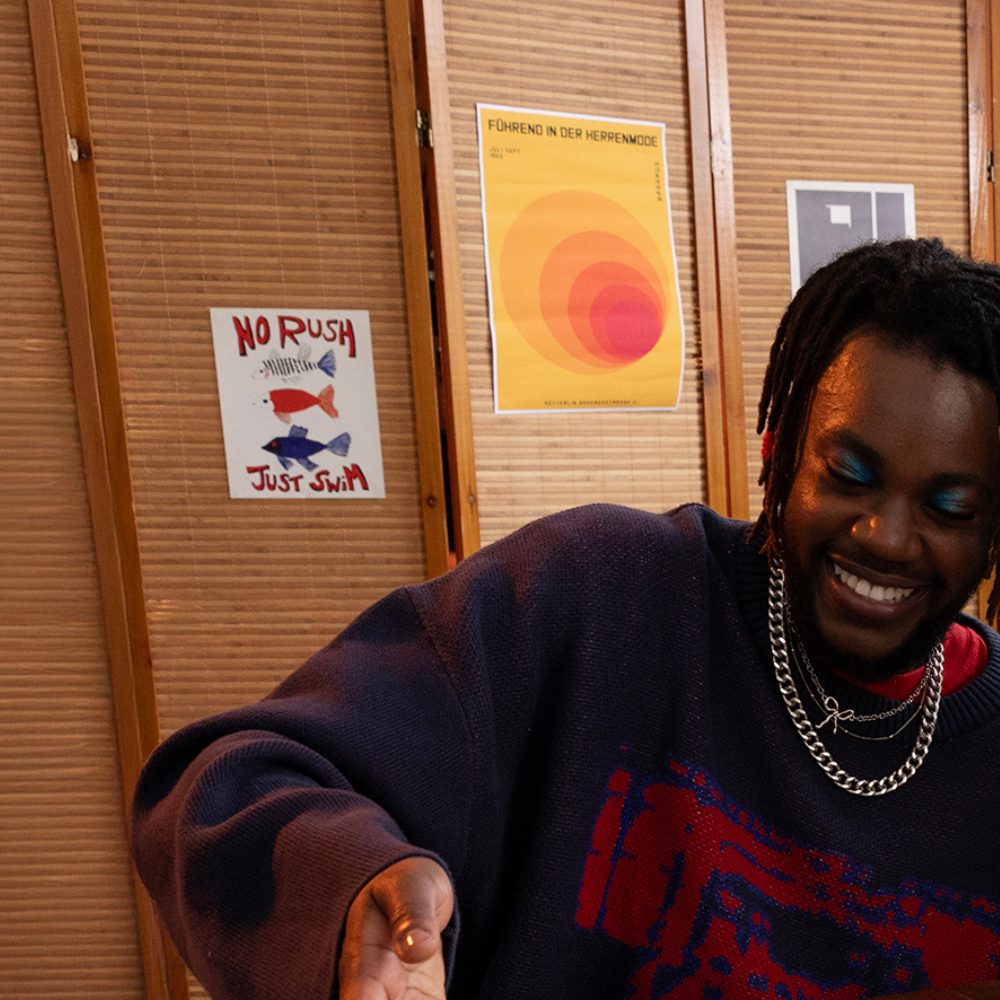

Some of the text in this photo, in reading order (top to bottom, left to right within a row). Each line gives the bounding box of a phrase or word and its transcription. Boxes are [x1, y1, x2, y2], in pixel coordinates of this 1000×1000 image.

[488, 118, 658, 147] FÜHREND IN DER HERRENMODE
[232, 315, 357, 358] NO RUSH
[246, 464, 304, 492] JUST
